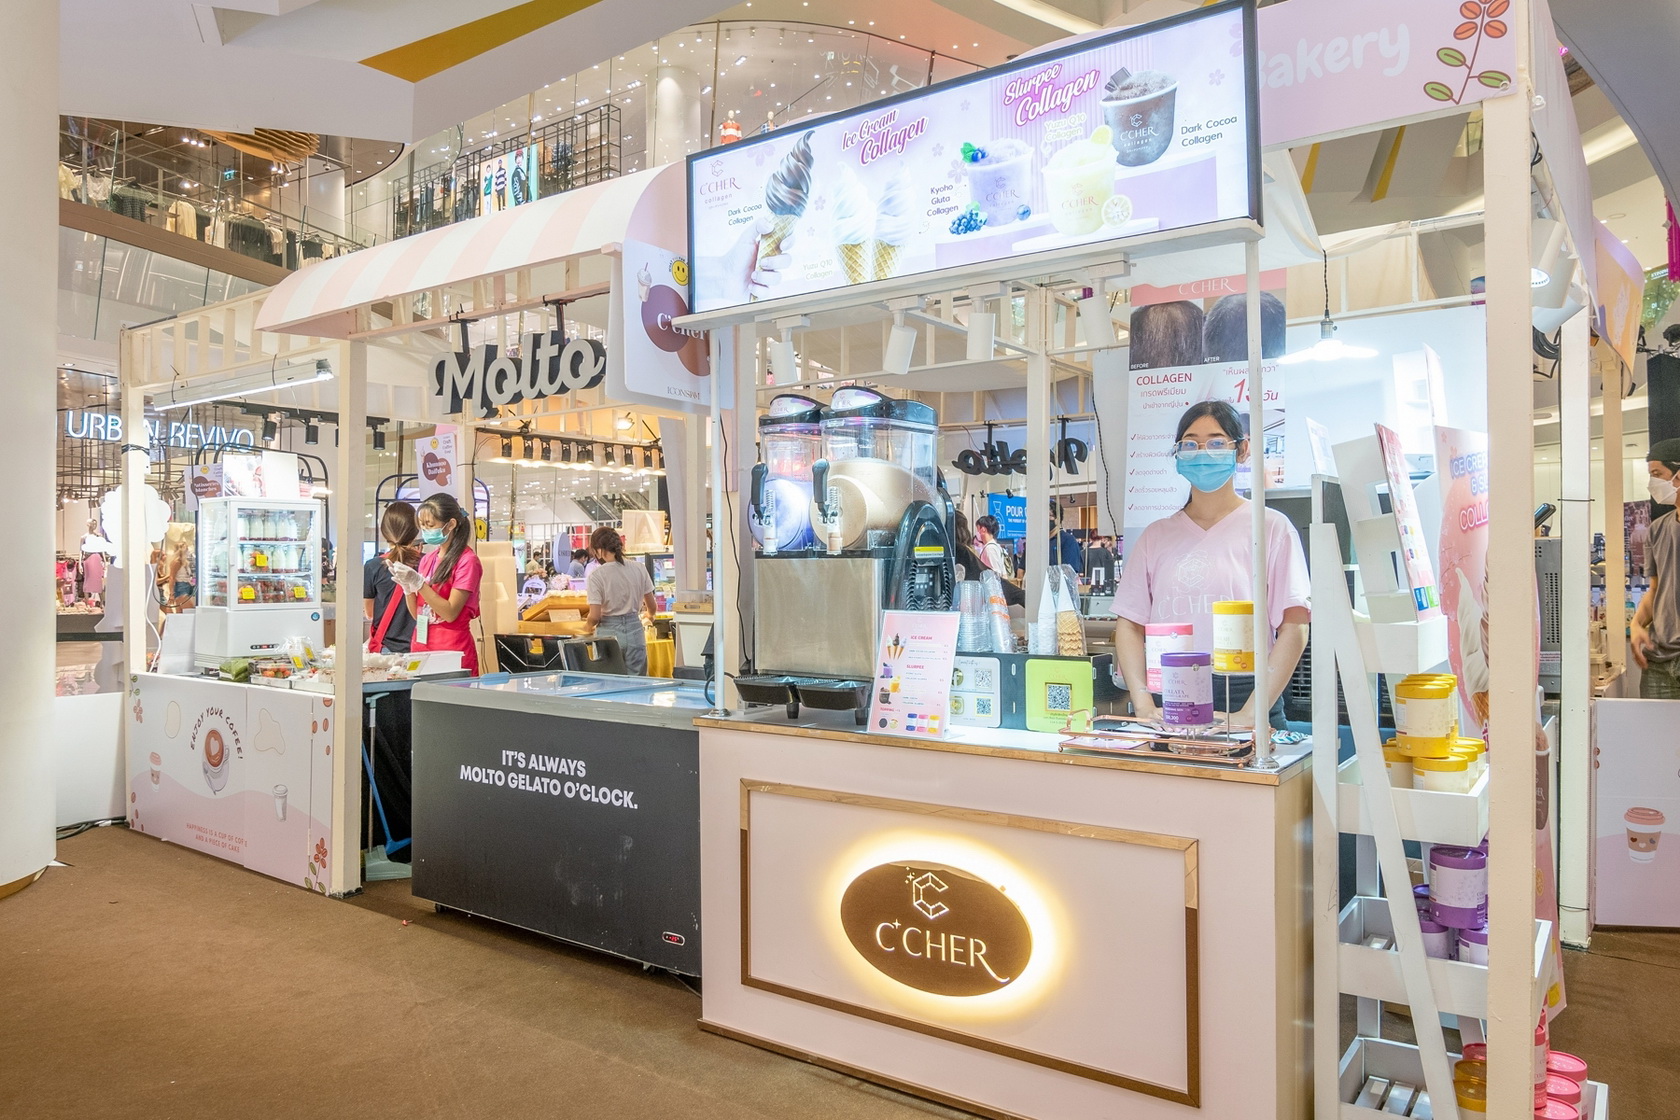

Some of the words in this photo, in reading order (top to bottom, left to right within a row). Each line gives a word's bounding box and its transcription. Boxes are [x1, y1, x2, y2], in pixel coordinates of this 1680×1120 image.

[1004, 64, 1062, 106] Slurpee
[1015, 69, 1100, 126] Collagen
[1044, 119, 1067, 130] Yuzu
[1069, 112, 1086, 126] Q10
[1181, 123, 1203, 135] Dark
[1205, 115, 1238, 129] Cocoa
[842, 132, 857, 150] Ice
[859, 110, 898, 139] Cream
[1045, 126, 1083, 140] Collagen
[860, 117, 927, 165] Collagen
[1181, 131, 1223, 147] Collagen
[930, 183, 954, 195] Kyoho
[931, 195, 951, 205] Gluta
[728, 208, 741, 217] Dark
[743, 203, 762, 213] Cocoa
[926, 205, 959, 217] Collagen
[728, 215, 753, 226] Collagen
[805, 270, 833, 280] Collagen
[1131, 362, 1149, 370] BEFORE
[428, 330, 606, 418] Molto
[1136, 373, 1192, 386] COLLAGEN
[1141, 387, 1186, 398] เกรดพรีเมียม
[67, 410, 160, 444] URBN
[169, 421, 255, 453] REVIVO
[1451, 457, 1465, 479] ICE
[1006, 505, 1024, 517] POUR
[190, 712, 204, 750] ENJOY
[206, 706, 223, 718] YOUR
[502, 750, 526, 768] IT'S
[528, 754, 586, 777] ALWAYS
[459, 765, 505, 786] MOLTO
[508, 772, 561, 796] GELATO
[563, 781, 638, 809] O'CLOCK.
[186, 823, 208, 835] HAPPINESS
[209, 838, 220, 847] PIECE
[228, 844, 239, 852] CAKE
